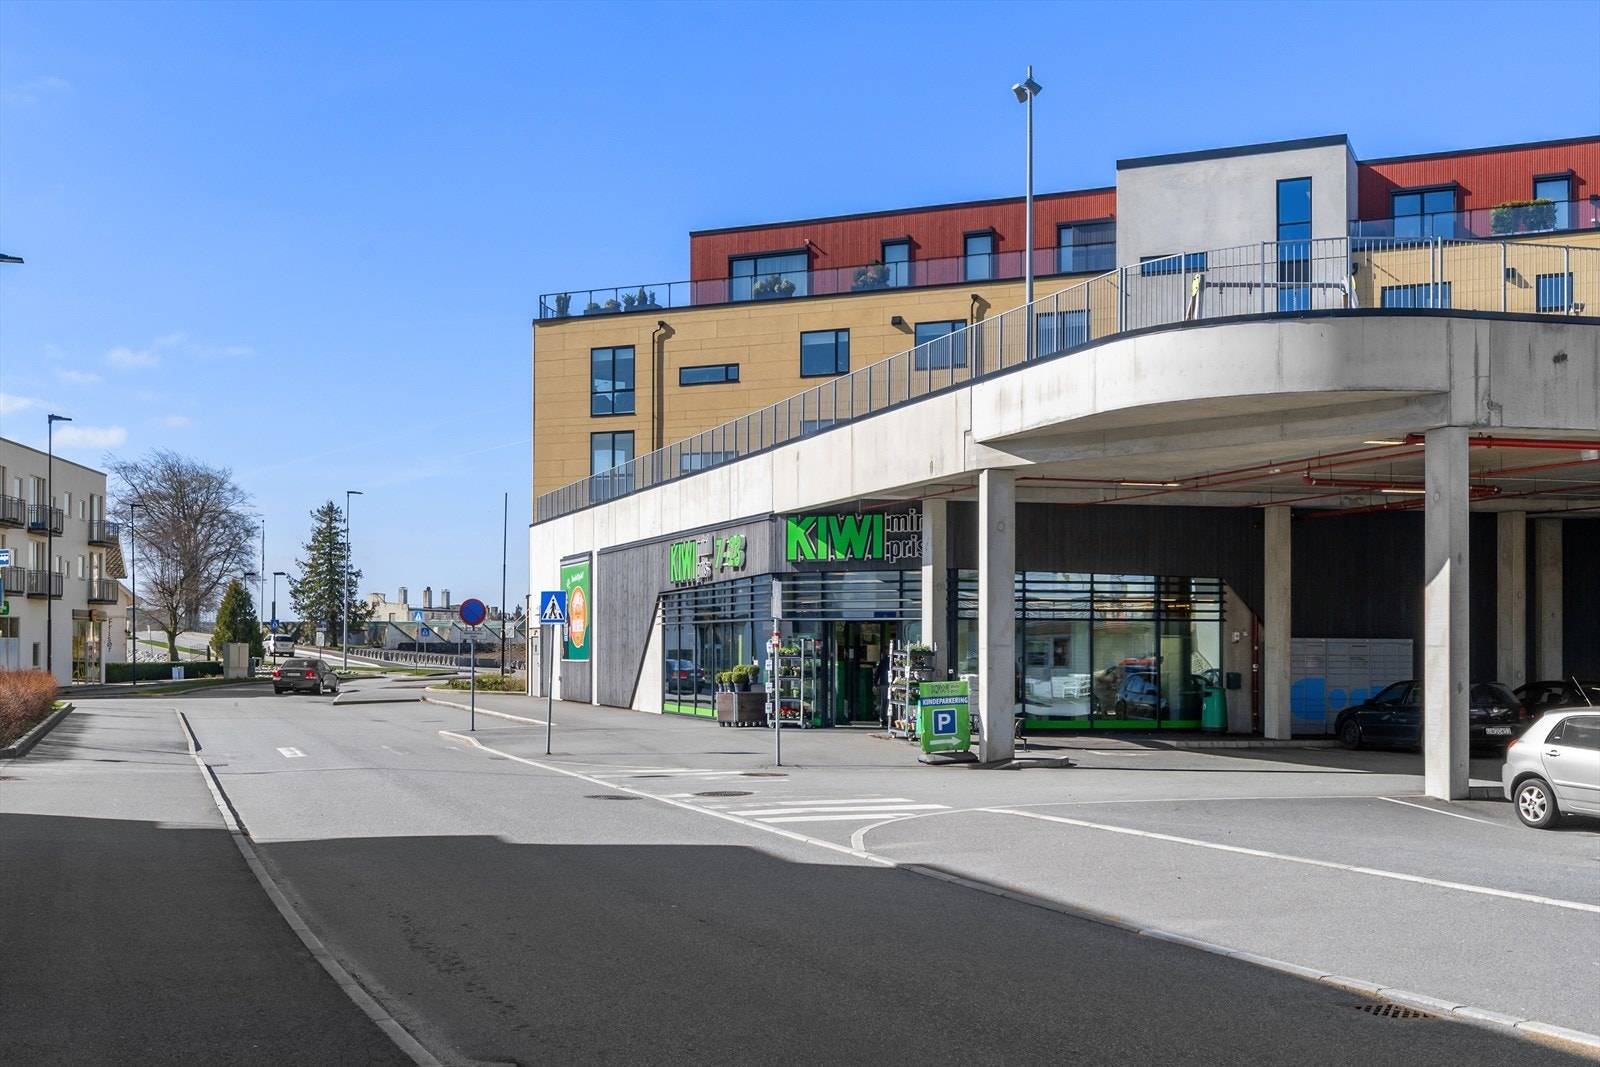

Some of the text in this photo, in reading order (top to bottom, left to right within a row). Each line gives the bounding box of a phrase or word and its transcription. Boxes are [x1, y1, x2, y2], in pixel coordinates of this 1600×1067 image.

[786, 513, 884, 562] KIWI
[670, 540, 697, 583] KIWI
[922, 697, 968, 706] KUNDEPARKERING
[938, 713, 951, 731] P
